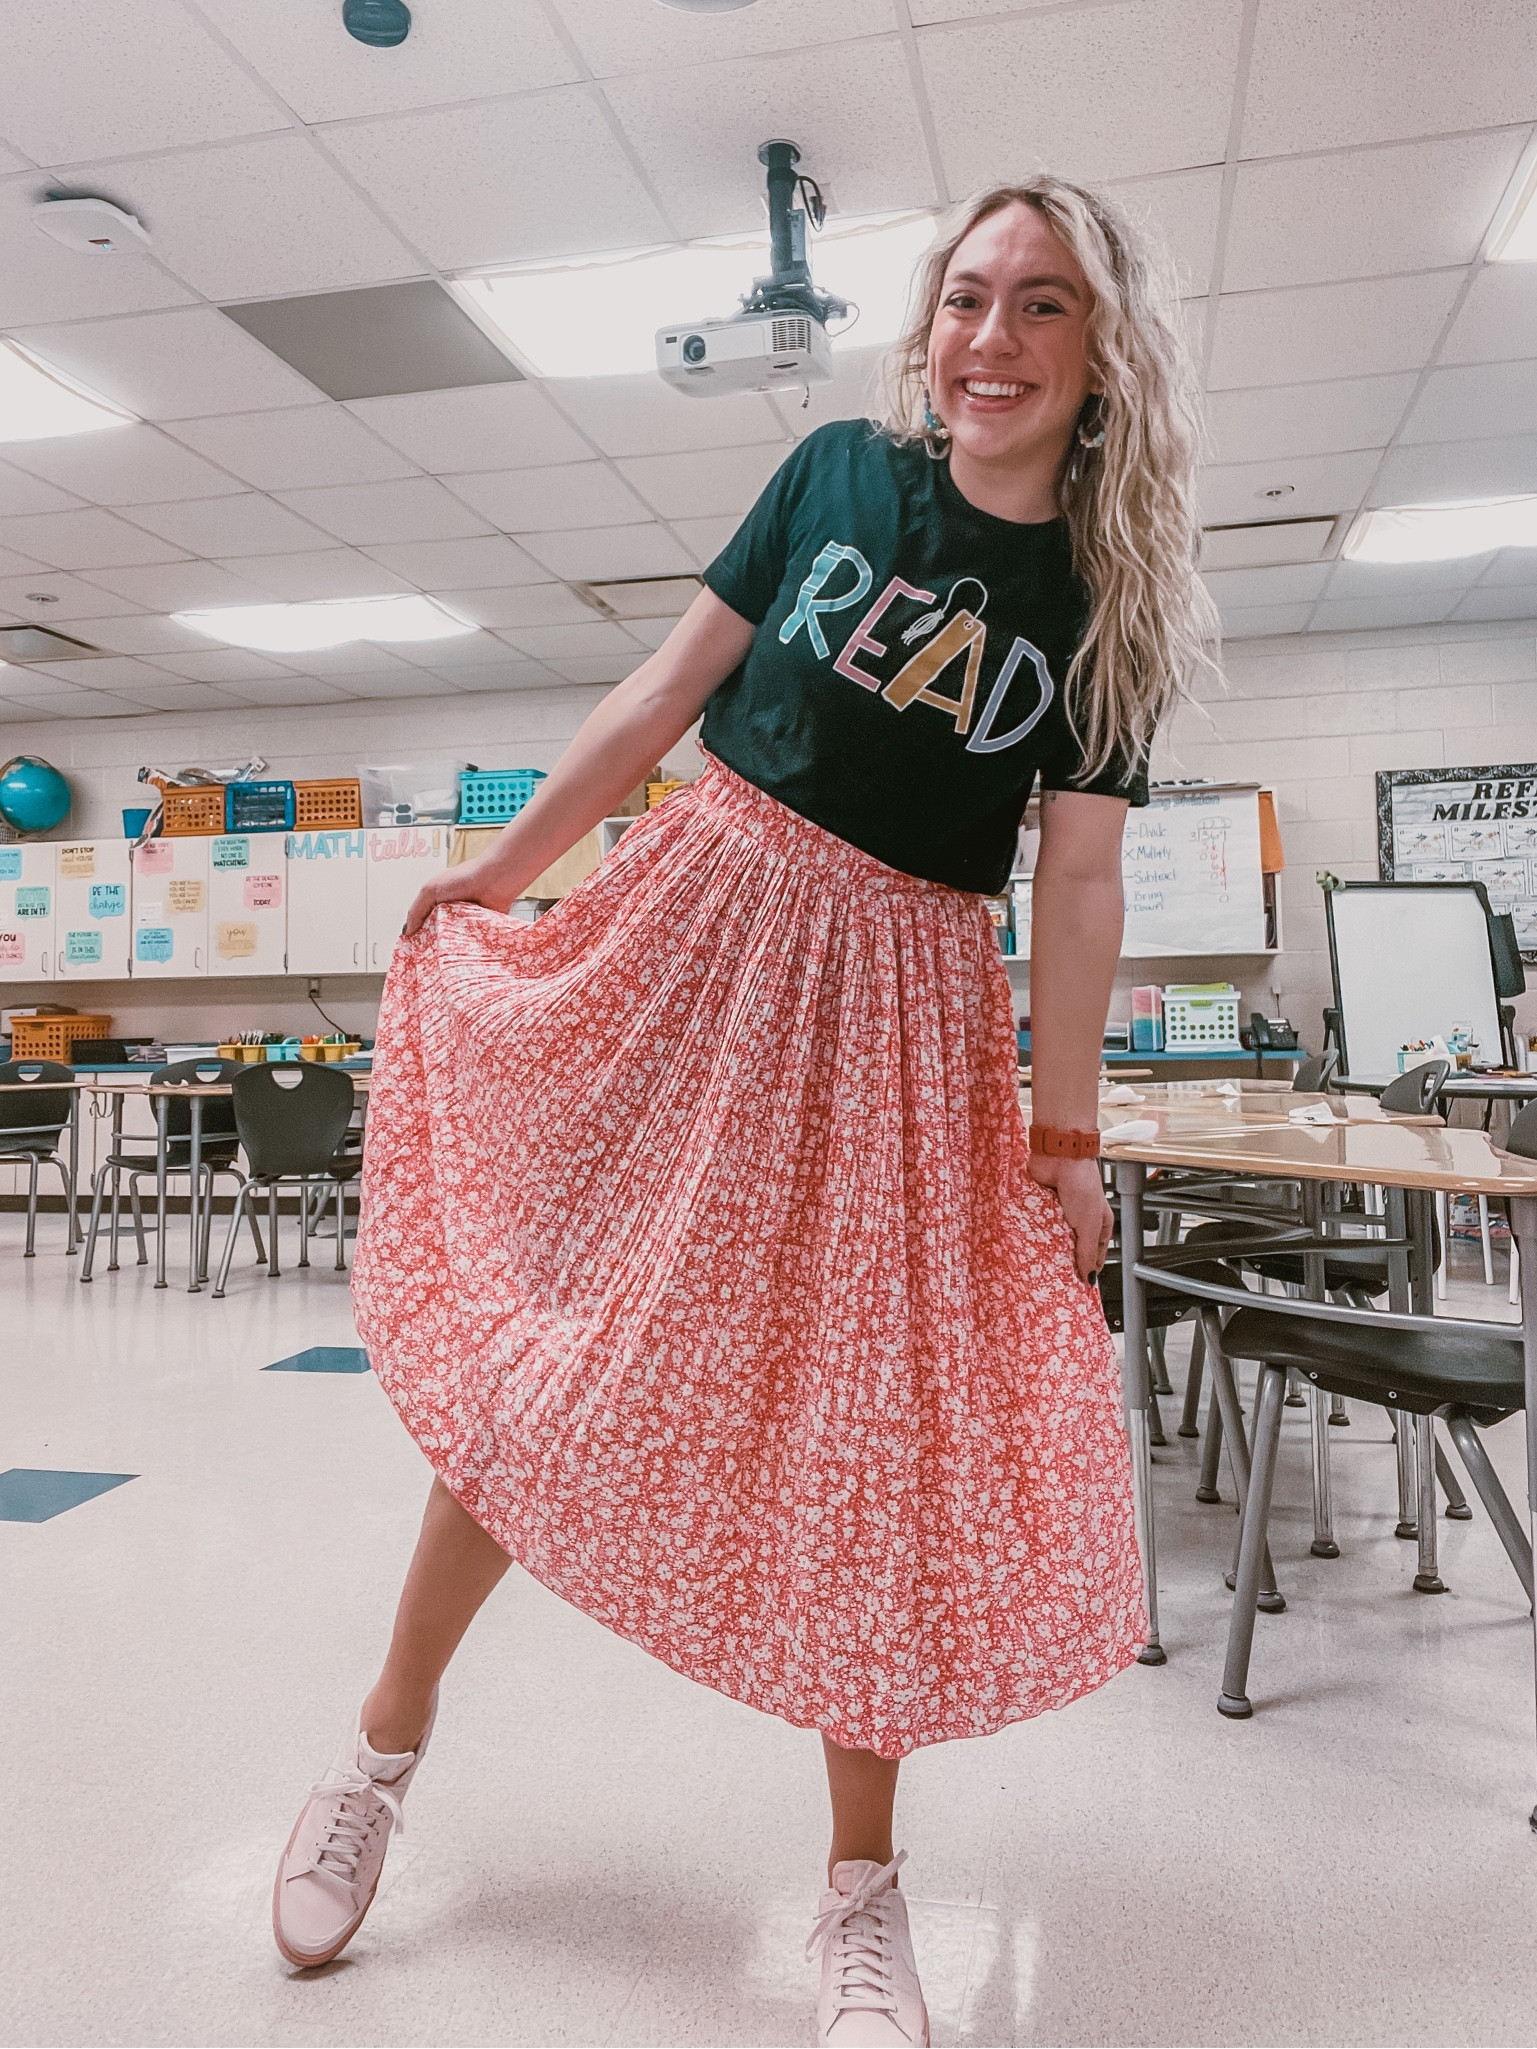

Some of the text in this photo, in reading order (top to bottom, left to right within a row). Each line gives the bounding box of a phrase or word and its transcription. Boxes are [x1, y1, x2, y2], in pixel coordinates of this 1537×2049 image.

[779, 540, 1054, 753] READ
[1472, 780, 1537, 800] REF
[288, 830, 364, 860] MATH
[1134, 868, 1176, 884] Subtract
[92, 886, 120, 895] BE THE
[89, 897, 124, 912] change
[226, 928, 247, 941] you
